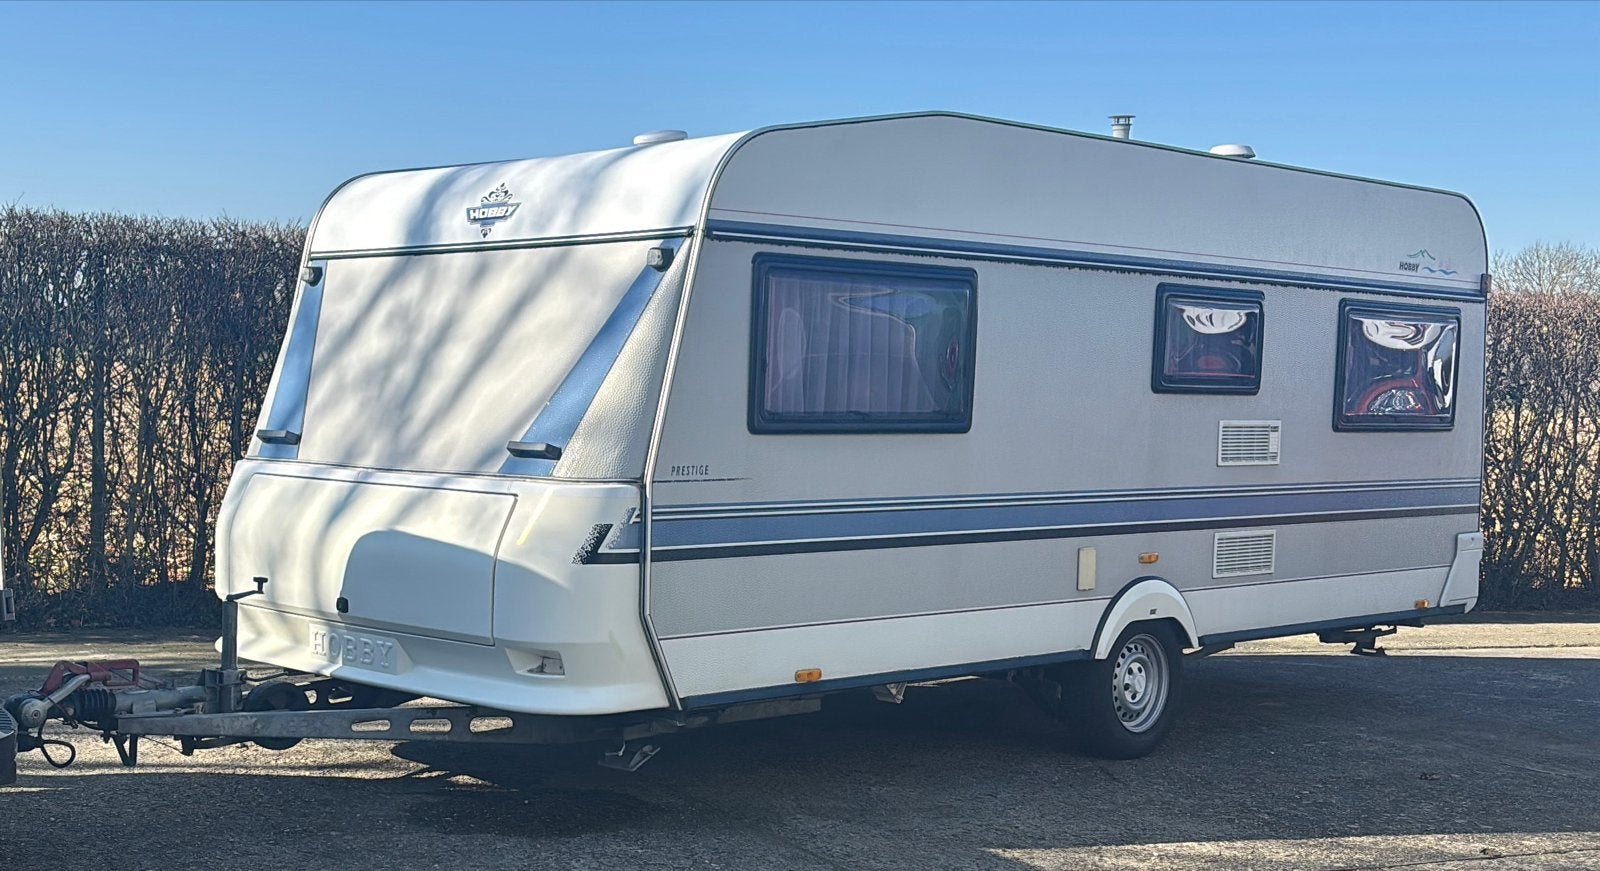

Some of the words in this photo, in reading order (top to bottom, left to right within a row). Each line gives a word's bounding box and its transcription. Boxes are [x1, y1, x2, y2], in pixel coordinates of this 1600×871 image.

[470, 206, 518, 219] HOBBY
[1399, 261, 1420, 272] HOBBY
[671, 465, 709, 476] PRESTIGE
[312, 631, 393, 667] HOBBY
